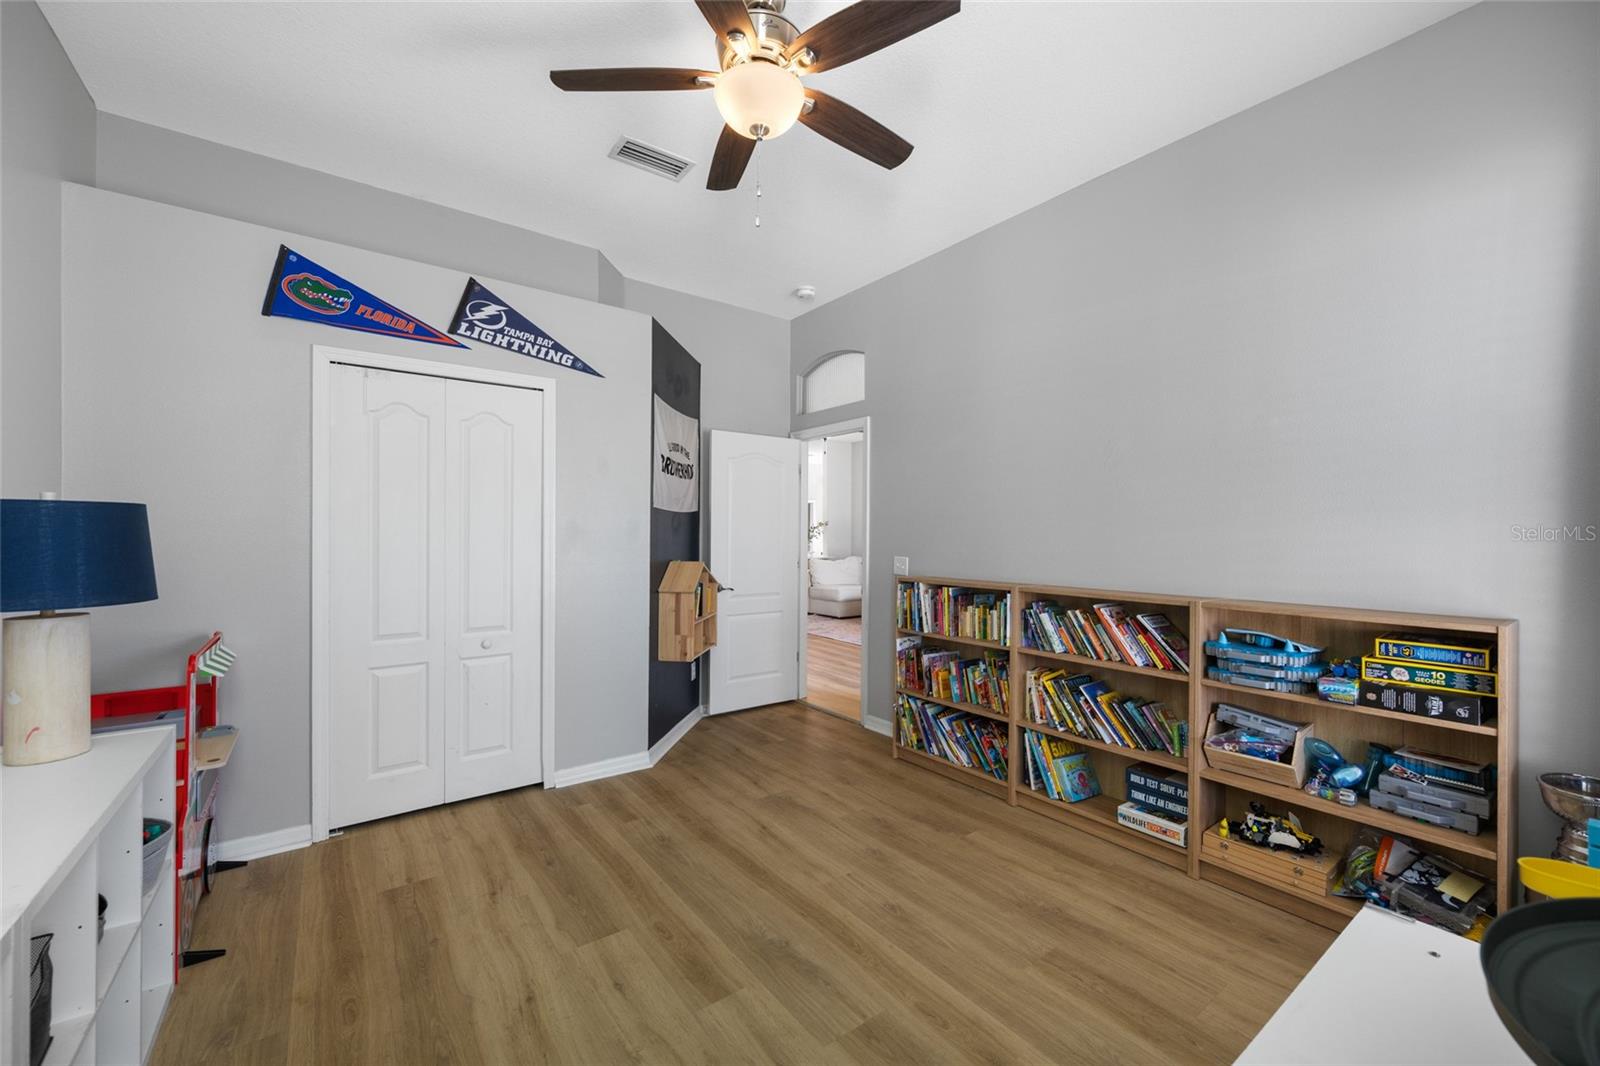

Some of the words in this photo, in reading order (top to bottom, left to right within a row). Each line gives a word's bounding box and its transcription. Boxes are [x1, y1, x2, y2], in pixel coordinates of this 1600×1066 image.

[355, 304, 417, 334] FLORIDA
[457, 321, 575, 367] LIGHTNING
[503, 326, 536, 343] TAMPA
[536, 336, 555, 348] BAY
[1414, 677, 1446, 686] GEODES
[1430, 671, 1446, 680] 10
[1130, 773, 1145, 785] BUILD
[1146, 778, 1158, 790] TEST
[1160, 783, 1176, 795] SOLVE
[1131, 789, 1146, 801] THINK
[1146, 794, 1157, 806] LIKE
[1157, 798, 1165, 808] AN
[1122, 814, 1147, 828] WILDLIFE
